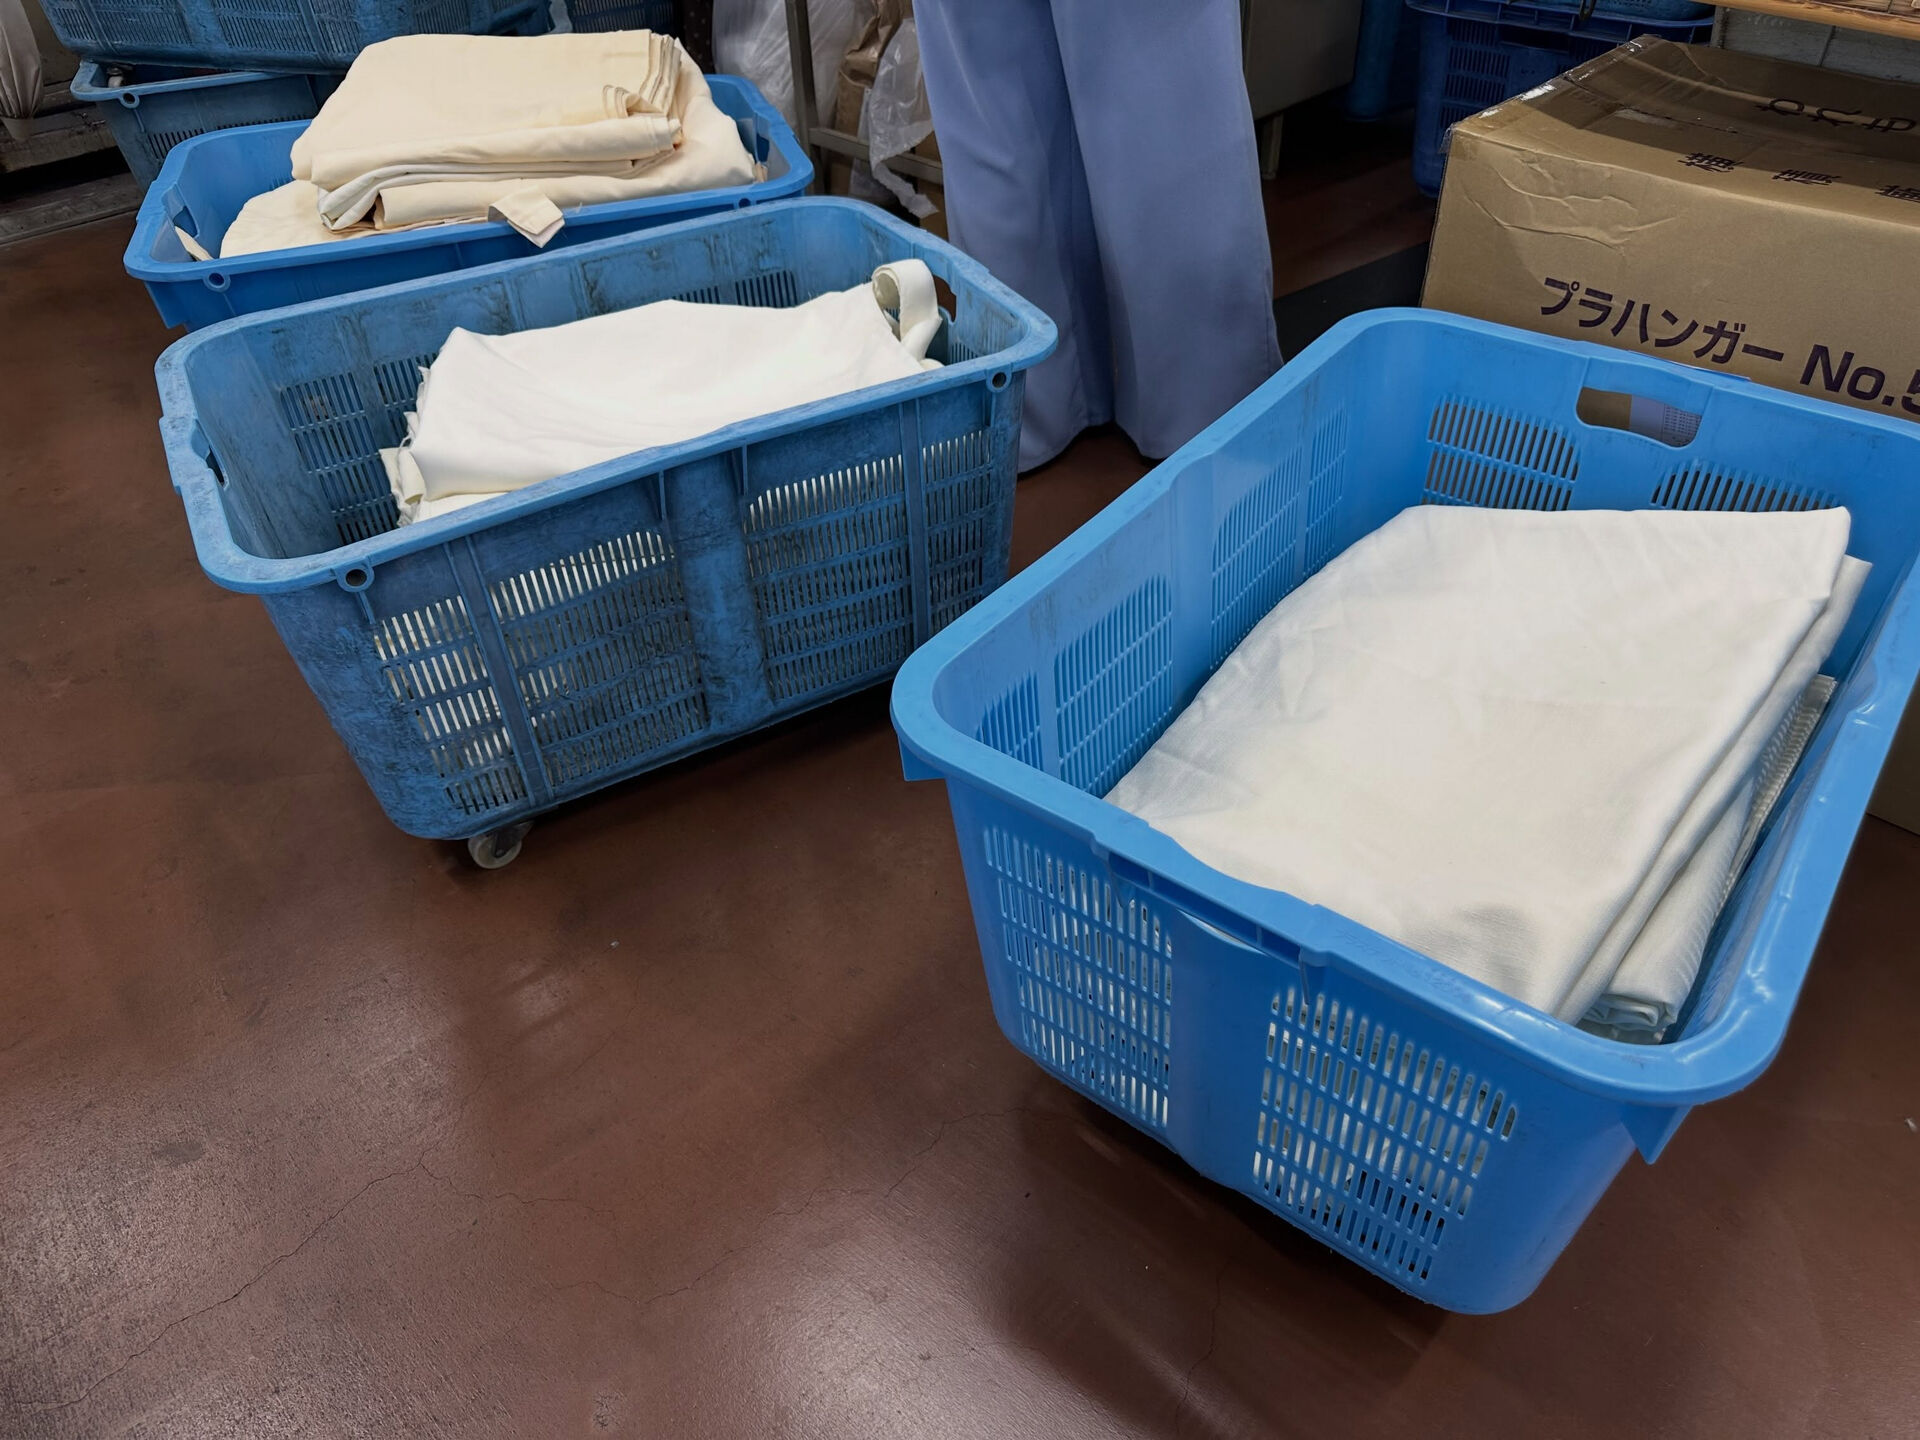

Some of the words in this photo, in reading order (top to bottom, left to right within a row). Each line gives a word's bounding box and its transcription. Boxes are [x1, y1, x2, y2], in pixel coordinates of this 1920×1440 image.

[1540, 277, 1785, 364] プラハンガー
